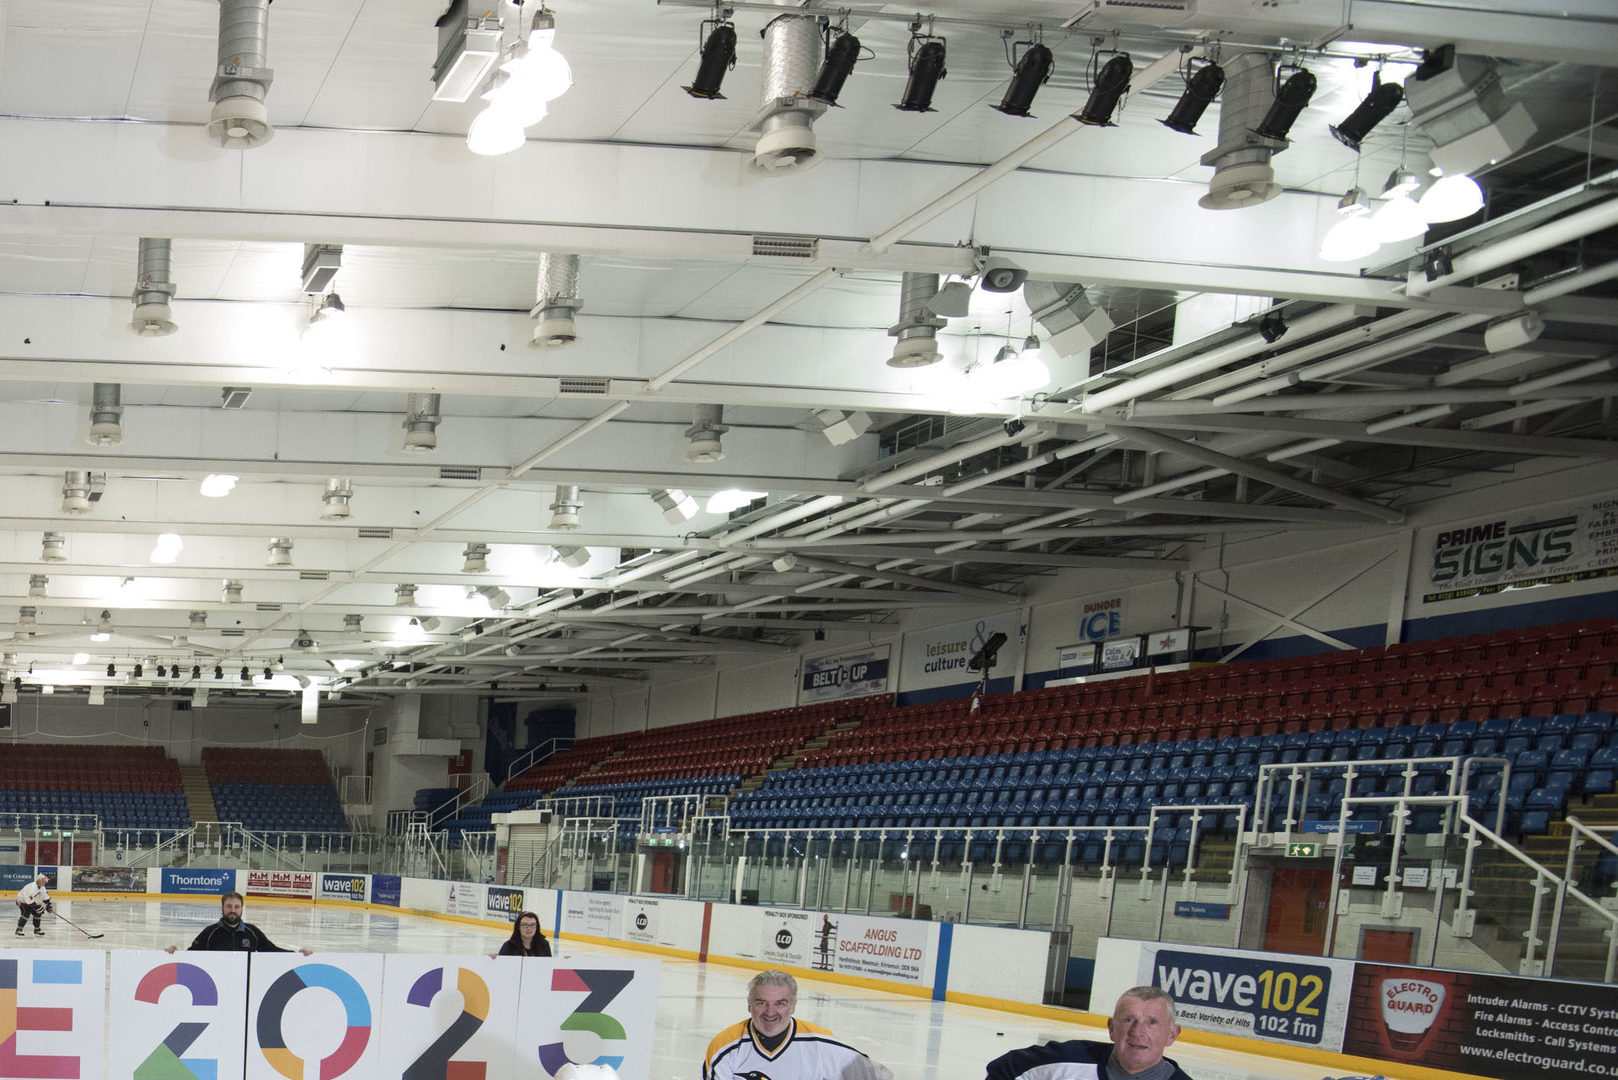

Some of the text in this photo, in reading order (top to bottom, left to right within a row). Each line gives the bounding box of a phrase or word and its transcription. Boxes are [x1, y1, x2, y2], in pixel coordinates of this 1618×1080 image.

[1437, 521, 1506, 548] PRIME
[1433, 528, 1577, 582] SIGNS
[1084, 598, 1121, 613] DUNDEE
[1079, 612, 1121, 641] ICE
[926, 640, 968, 657] leisure
[924, 655, 966, 673] culture
[812, 665, 868, 688] BELT UP
[170, 874, 223, 886] Thorntons
[324, 878, 365, 893] wave102
[489, 893, 523, 912] wave102
[636, 917, 647, 926] LCD
[776, 934, 792, 944] LCD
[864, 928, 898, 942] ANGUS
[839, 940, 922, 960] SCAFFOLDING LTD
[1158, 965, 1324, 1016] wave102
[1386, 982, 1438, 1004] ELECTRO
[1387, 1000, 1434, 1015] GUARD
[1467, 994, 1510, 1008] Intruder
[1511, 998, 1549, 1012] Alarms
[1558, 1004, 1588, 1016] CCTV
[1180, 1009, 1251, 1028] Best Variety of Hits
[1259, 1014, 1317, 1038] 102 fm
[1474, 1010, 1494, 1021] Fire
[1496, 1014, 1533, 1027] Alarms
[1542, 1019, 1581, 1033] Access
[1476, 1027, 1617, 1054] Locksmiths Call Systems
